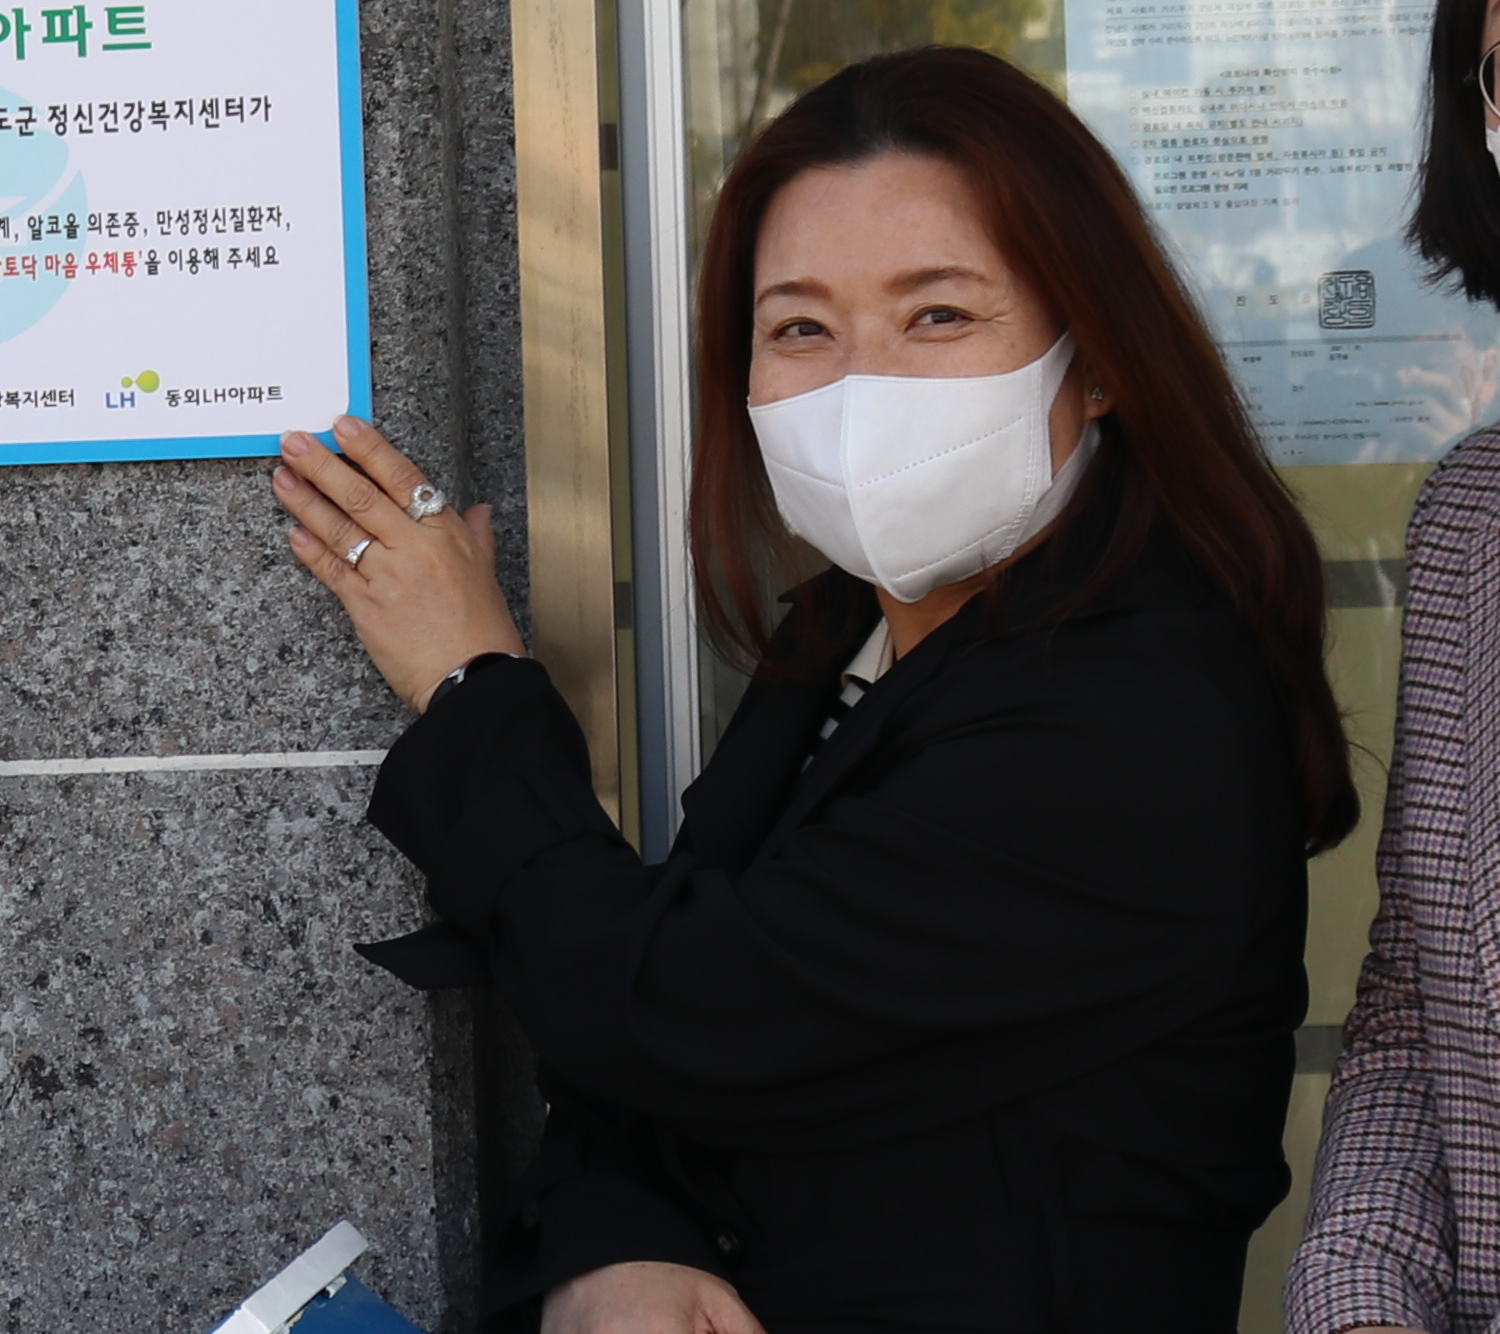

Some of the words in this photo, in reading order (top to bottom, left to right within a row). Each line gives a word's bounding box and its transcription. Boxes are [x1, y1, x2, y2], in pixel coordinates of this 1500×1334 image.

[47, 95, 272, 136] 정신건강복지센터가
[26, 212, 80, 241] 알코올
[87, 211, 148, 238] 의존증,
[156, 205, 291, 236] 만성정신질환자,
[44, 252, 79, 279] 마음
[167, 246, 220, 275] 이용해
[226, 245, 280, 270] 주세요
[104, 390, 136, 409] LH
[164, 385, 284, 407] 동외LH아파트
